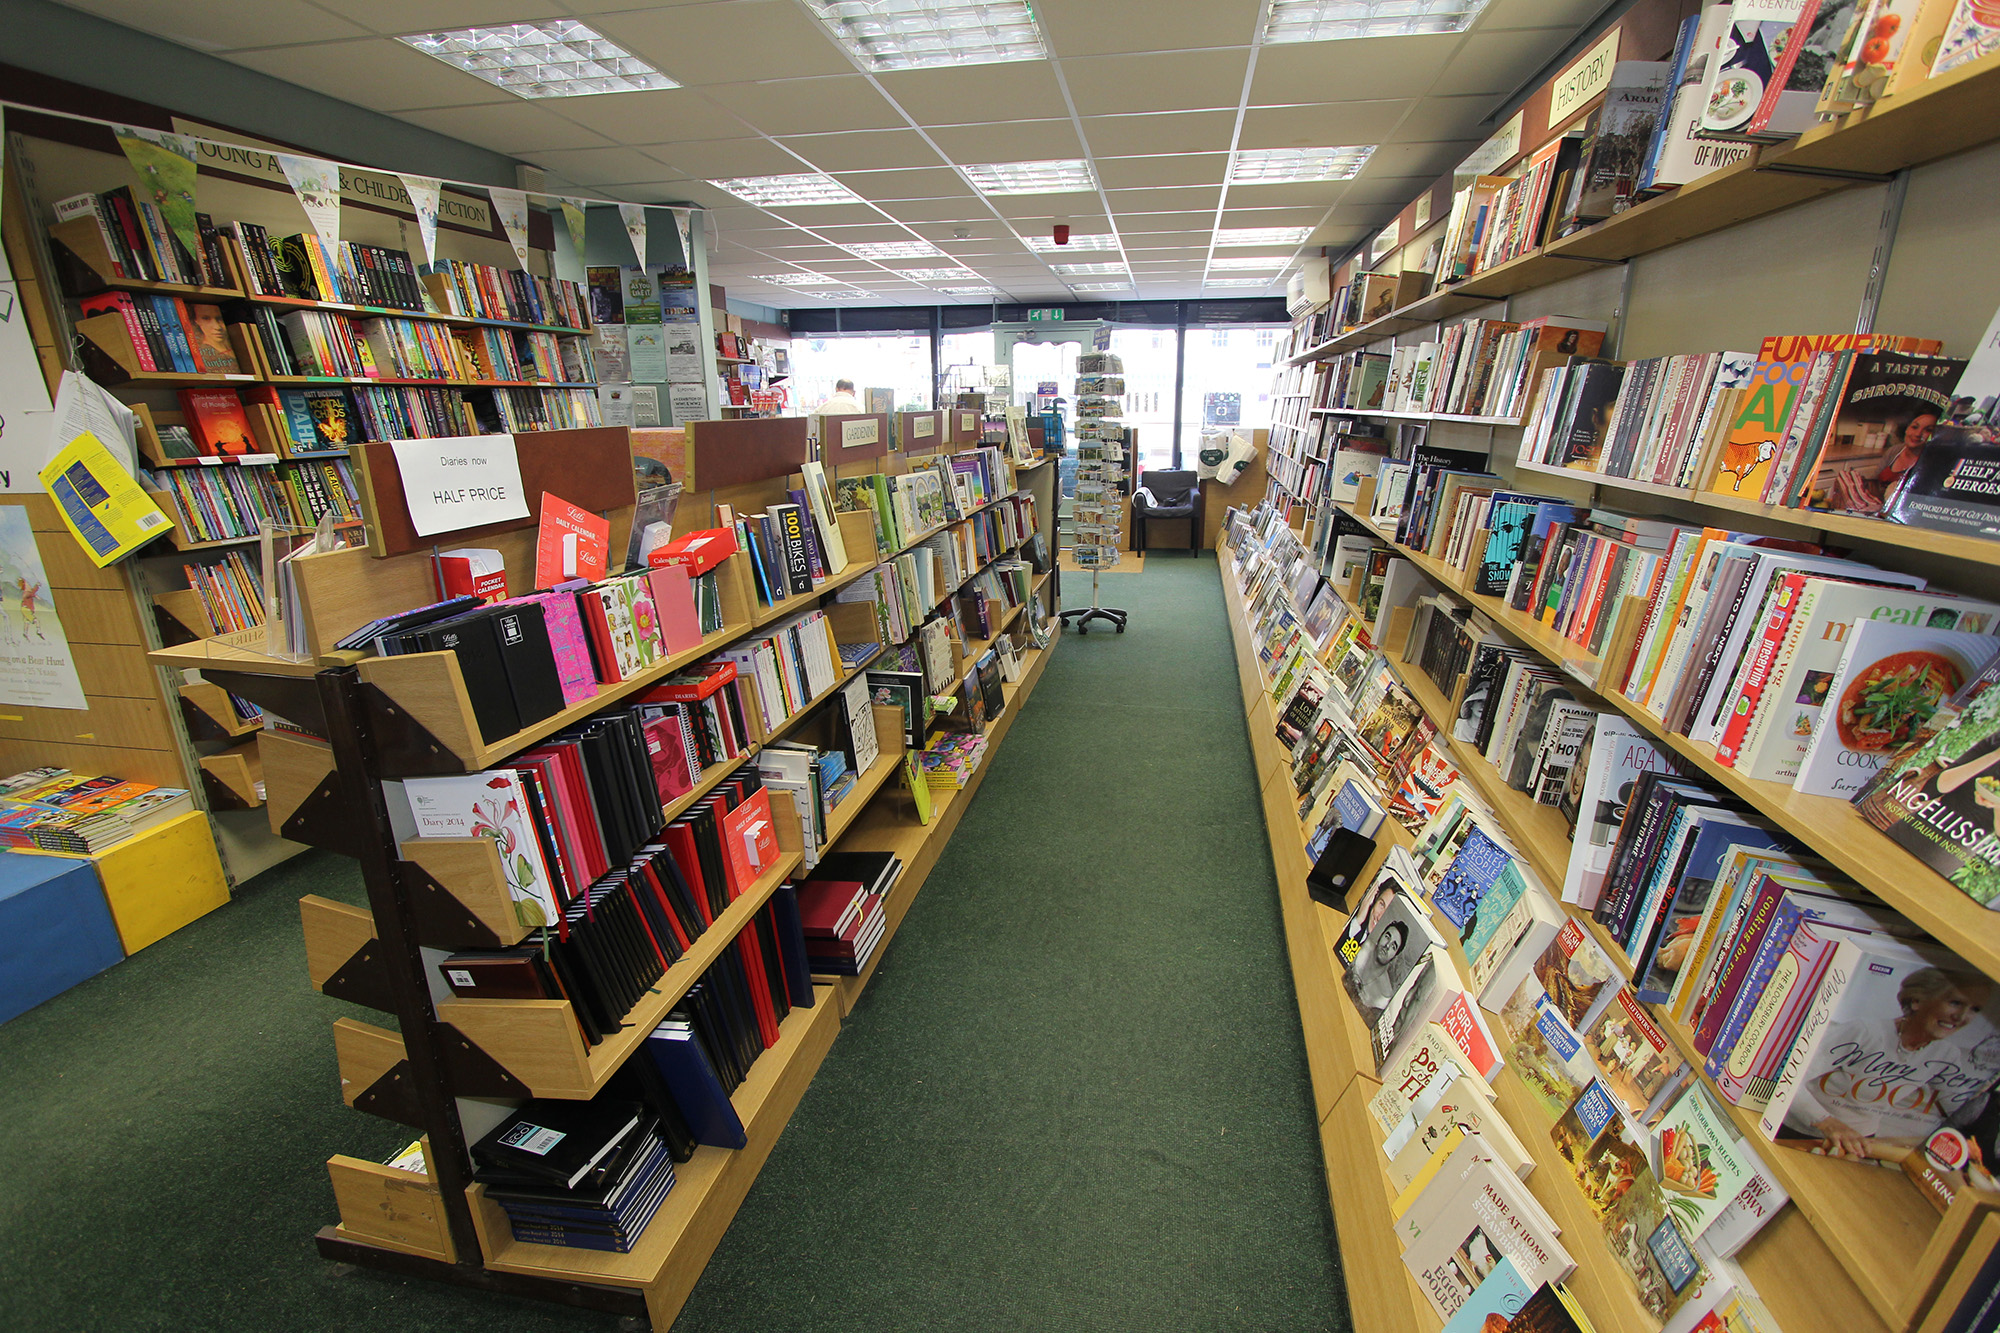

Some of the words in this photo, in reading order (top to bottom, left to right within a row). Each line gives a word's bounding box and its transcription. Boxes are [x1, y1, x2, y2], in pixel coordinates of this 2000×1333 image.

[1556, 49, 1610, 111] HISTORY
[194, 138, 262, 168] OUNG
[1694, 146, 1710, 166] OF
[340, 172, 351, 189] &
[438, 201, 486, 222] FICTION
[1872, 362, 1881, 373] A
[1885, 362, 1926, 376] TASTE
[1932, 365, 1950, 378] OF
[309, 399, 344, 409] MORTAL
[318, 390, 344, 398] DICKINSON
[1850, 382, 1949, 409] SHROPSHIRE
[314, 408, 346, 418] CHAOS
[846, 424, 877, 442] GARDENING
[1668, 422, 1676, 438] IAN
[441, 456, 468, 468] Diaries
[472, 457, 488, 466] now
[1416, 454, 1429, 462] The
[1430, 454, 1452, 465] History
[1660, 438, 1670, 464] KELLY
[1960, 465, 1995, 479] HELP
[314, 483, 328, 511] FEAR
[433, 488, 466, 504] HALF
[470, 486, 506, 502] PRICE
[1951, 478, 2000, 495] HEROES
[305, 484, 320, 519] ENEMY
[1908, 500, 1942, 514] FOREWORD
[1950, 508, 1967, 518] CAPT
[1966, 510, 1981, 520] GUY
[567, 506, 585, 523] Letts
[786, 510, 800, 540] 1001
[555, 517, 571, 529] DAILY
[571, 524, 596, 541] CALENDAR
[579, 550, 598, 566] Letts
[790, 540, 806, 572] BIKES
[1664, 552, 1672, 568] THE
[478, 582, 505, 595] CALENDAR
[480, 576, 502, 588] POCKET
[1742, 562, 1756, 594] WHAT
[1596, 580, 1607, 602] LENI
[1648, 568, 1664, 613] MEDIEVAL
[1650, 585, 1668, 630] EVERYDAY
[1732, 596, 1744, 612] TO
[1802, 592, 1815, 618] eat
[1870, 604, 1929, 625] eat
[1634, 614, 1650, 652] KITCHEN
[1724, 614, 1736, 636] EAT
[1784, 620, 1804, 658] more
[46, 656, 64, 666] Hunt
[1712, 638, 1726, 666] NEXT
[1748, 638, 1775, 688] preserving
[1772, 658, 1790, 688] veg
[1833, 657, 1848, 681] COOK
[675, 692, 698, 700] DIARIES
[1765, 692, 1773, 711] arthur
[1826, 681, 1839, 700] THAI
[1384, 716, 1395, 730] WAR
[1389, 712, 1408, 732] WORLD
[1748, 726, 1760, 752] dawson
[1622, 745, 1656, 771] AGA
[1836, 750, 1884, 770] COOK
[1422, 764, 1446, 786] BRIDGE
[1423, 758, 1452, 783] LONDON
[1413, 769, 1444, 798] AMERICA
[735, 821, 746, 832] DAILY
[746, 806, 762, 824] CALENDAR
[1351, 810, 1360, 822] WHY
[1641, 806, 1653, 824] HOW
[1655, 800, 1664, 817] Paul
[422, 817, 444, 828] Diary
[446, 818, 465, 827] 2014
[1638, 825, 1646, 836] TO
[1668, 812, 1684, 848] JAMIE
[1678, 816, 1690, 840] MARY
[758, 836, 770, 849] Letts
[1630, 835, 1643, 857] BAKE
[1884, 800, 1916, 826] INSTANT
[1912, 818, 1944, 844] ITALIAN
[1940, 838, 1990, 876] INSPIRATION
[1467, 847, 1498, 878] PEOPLE
[1469, 837, 1508, 872] CARELESS
[1625, 858, 1634, 873] PAUL
[1652, 850, 1670, 885] OLIVER
[1667, 856, 1686, 887] FOOD
[1610, 875, 1628, 915] HOLLYWOOD
[1651, 892, 1662, 911] FOOD
[1740, 872, 1760, 910] Student
[1618, 892, 1630, 920] PUDS
[1653, 897, 1671, 924] LOVE
[1631, 912, 1646, 946] KITCHEN
[1722, 910, 1745, 952] Cookbook
[1744, 895, 1774, 944] cooking
[1774, 917, 1783, 938] Cook
[1560, 934, 1574, 950] RECIPES
[1564, 925, 1580, 947] WELSH
[1765, 938, 1774, 950] Up
[1714, 950, 1726, 974] SOPHIE
[1734, 940, 1747, 962] for
[1722, 961, 1735, 988] real
[1752, 957, 1766, 980] Feast
[1782, 968, 1792, 982] THE
[1742, 980, 1752, 999] MARY
[1820, 968, 1847, 1007] Mary
[1734, 997, 1746, 1018] BERRY
[1757, 982, 1786, 1030] BLOOMSBURY
[1452, 997, 1460, 1008] A
[1456, 1006, 1474, 1040] GIRL
[1628, 1002, 1651, 1034] LEFTOVERS
[1649, 1028, 1666, 1049] RECIPES
[1805, 1008, 1830, 1044] Berry
[1426, 1033, 1444, 1054] ANDY
[1445, 1008, 1471, 1056] CALLED
[1542, 1014, 1576, 1052] HEREFORDSHIRE
[1554, 1036, 1570, 1054] VALLEY
[1738, 1028, 1761, 1066] COOKBOOK
[1774, 1036, 1808, 1103] COOKS
[1830, 1042, 1918, 1088] Mary
[1590, 1088, 1608, 1120] BRITISH
[1819, 1070, 1948, 1116] COOK
[1582, 1102, 1598, 1128] RECIPES
[1584, 1094, 1604, 1128] SAUSAGE
[508, 1126, 530, 1144] ECO
[1696, 1110, 1710, 1134] YOUR
[1707, 1130, 1720, 1147] OWN
[1717, 1142, 1742, 1178] RECIPES
[1922, 1168, 1934, 1182] SI
[1478, 1192, 1502, 1220] DICK
[1499, 1219, 1508, 1230] &
[1506, 1230, 1540, 1270] JAMES
[1482, 1184, 1510, 1216] MADE
[1507, 1214, 1523, 1230] AT
[1520, 1228, 1550, 1264] HOME
[1472, 1200, 1534, 1278] STRAWBRIDGE
[1660, 1226, 1674, 1246] PUB
[1671, 1245, 1691, 1275] FOOD
[1434, 1264, 1465, 1308] EGGS
[1504, 1270, 1518, 1287] THE
